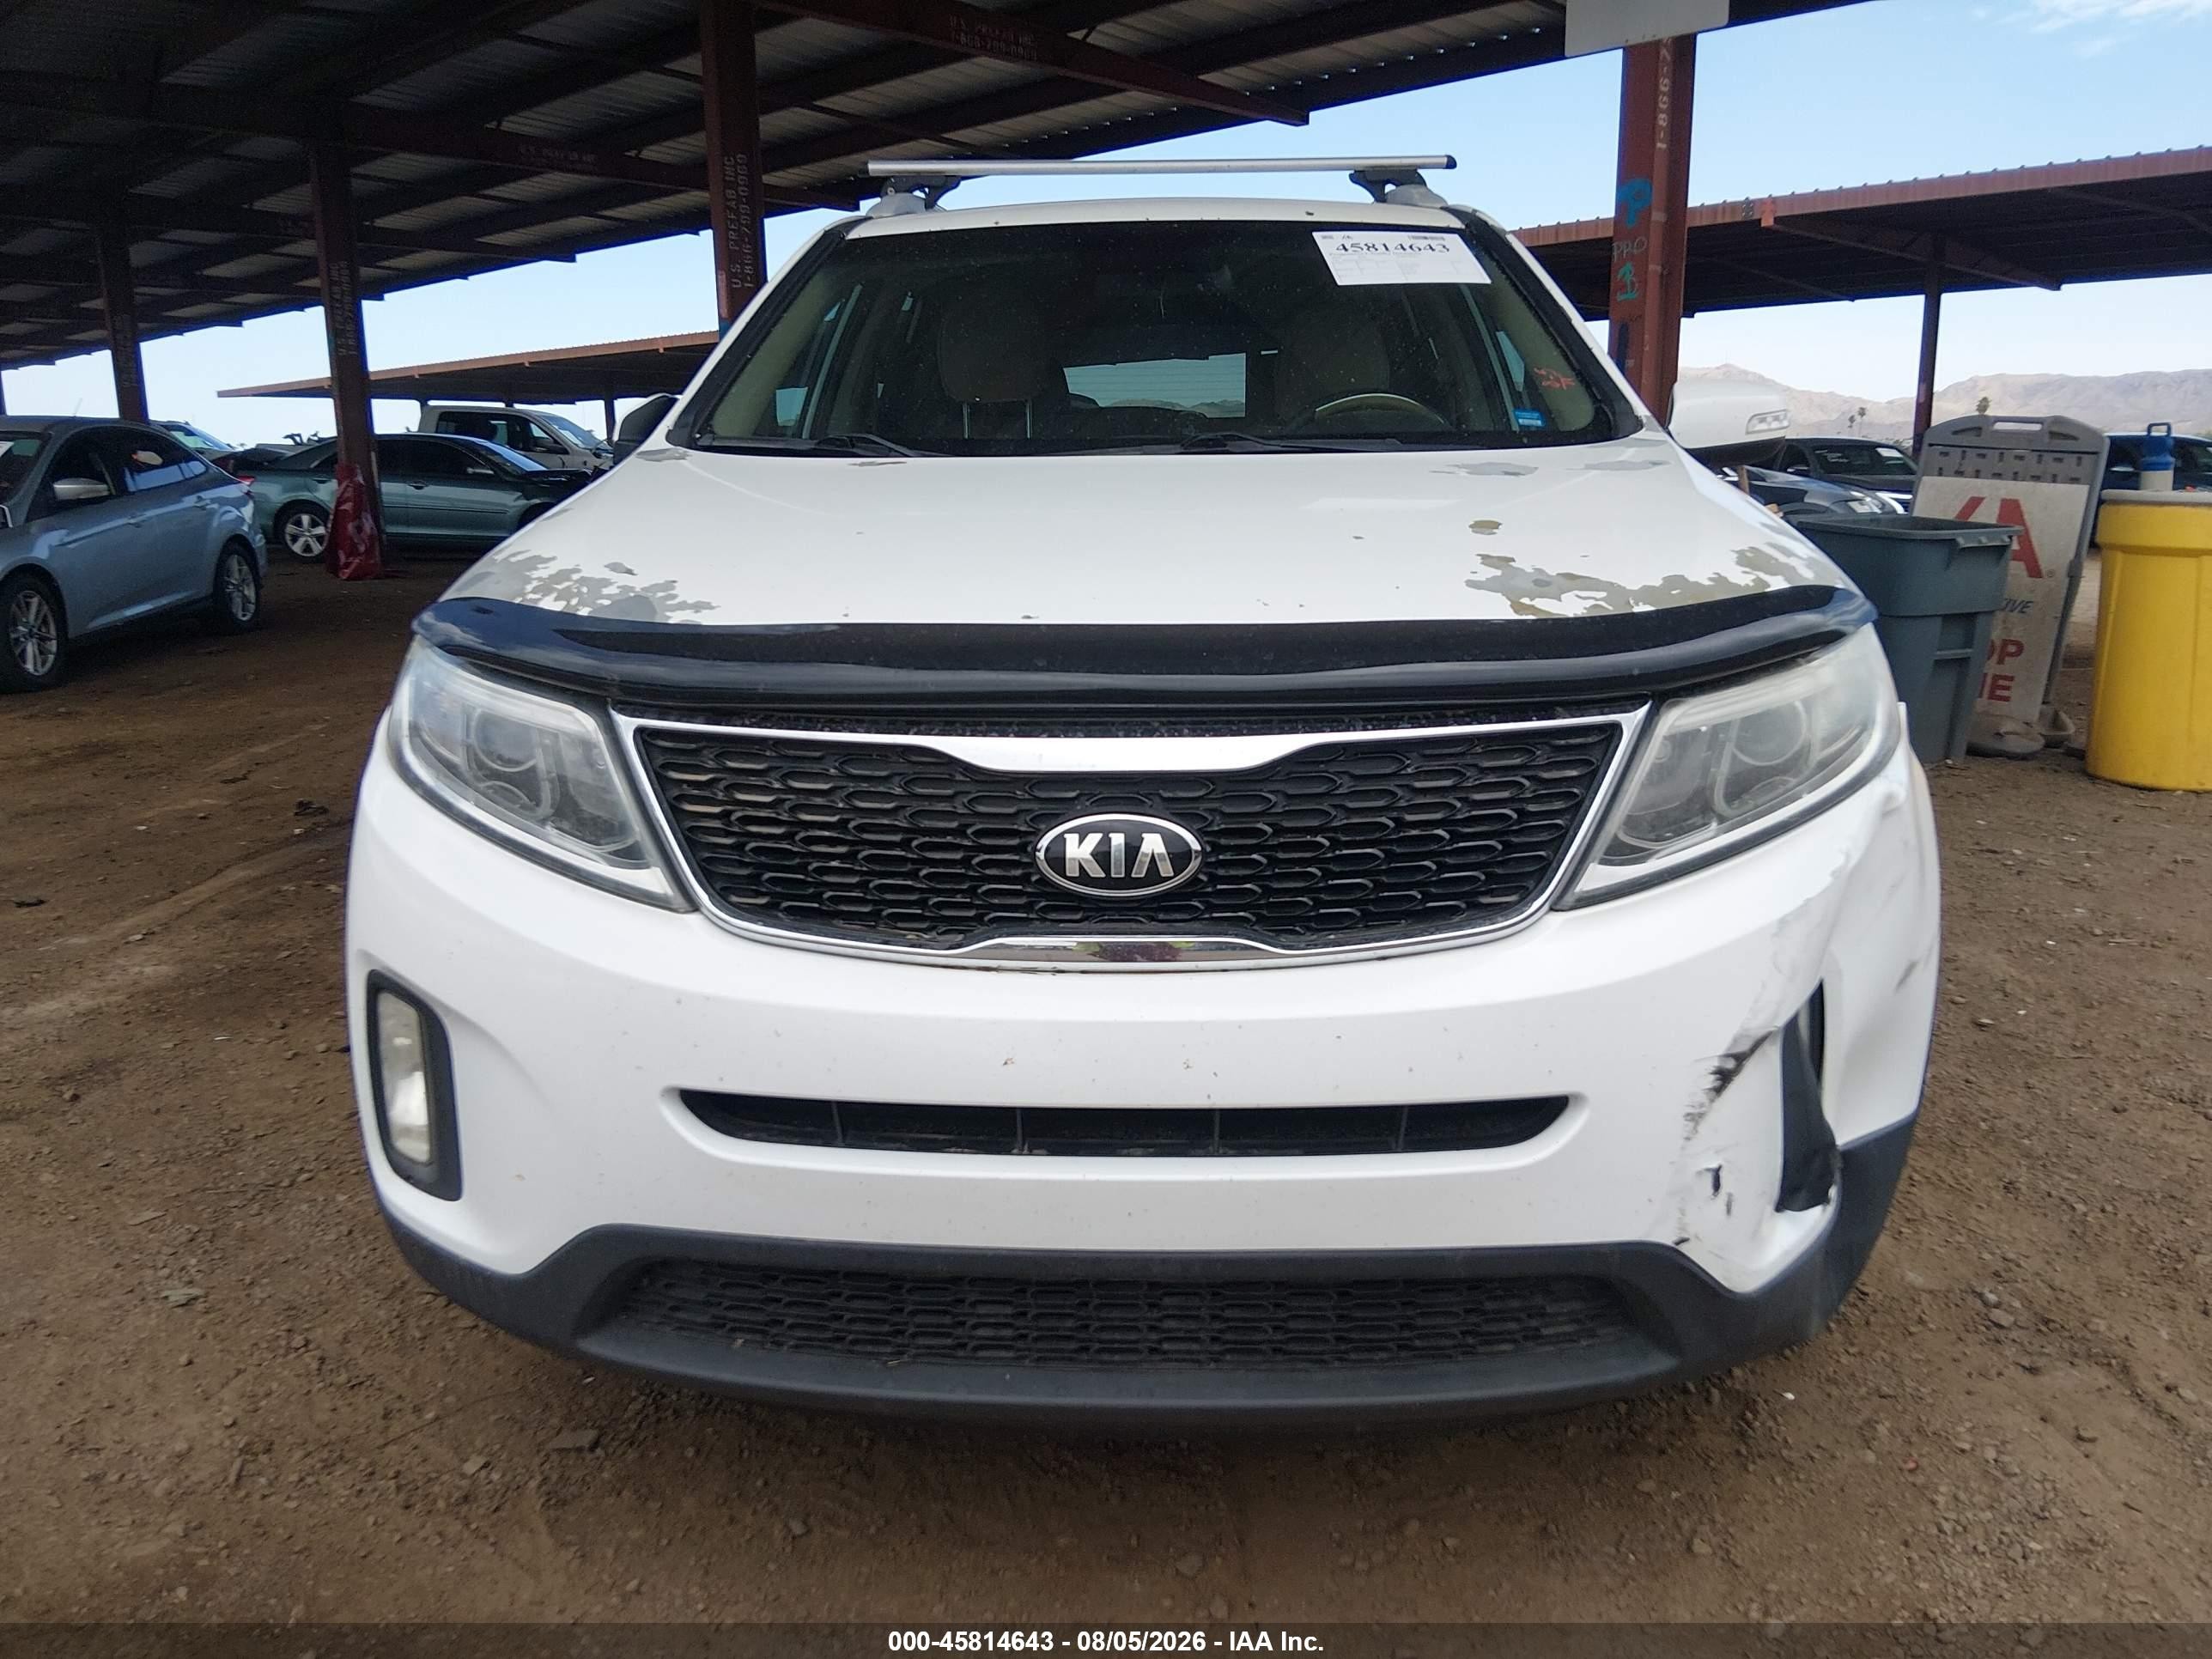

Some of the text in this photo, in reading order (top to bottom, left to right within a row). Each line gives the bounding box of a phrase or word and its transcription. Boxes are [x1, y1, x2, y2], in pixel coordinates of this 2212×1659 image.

[725, 189, 740, 251] PREFAB
[1335, 242, 1450, 253] 45814643
[1063, 832, 1175, 878] KIA
